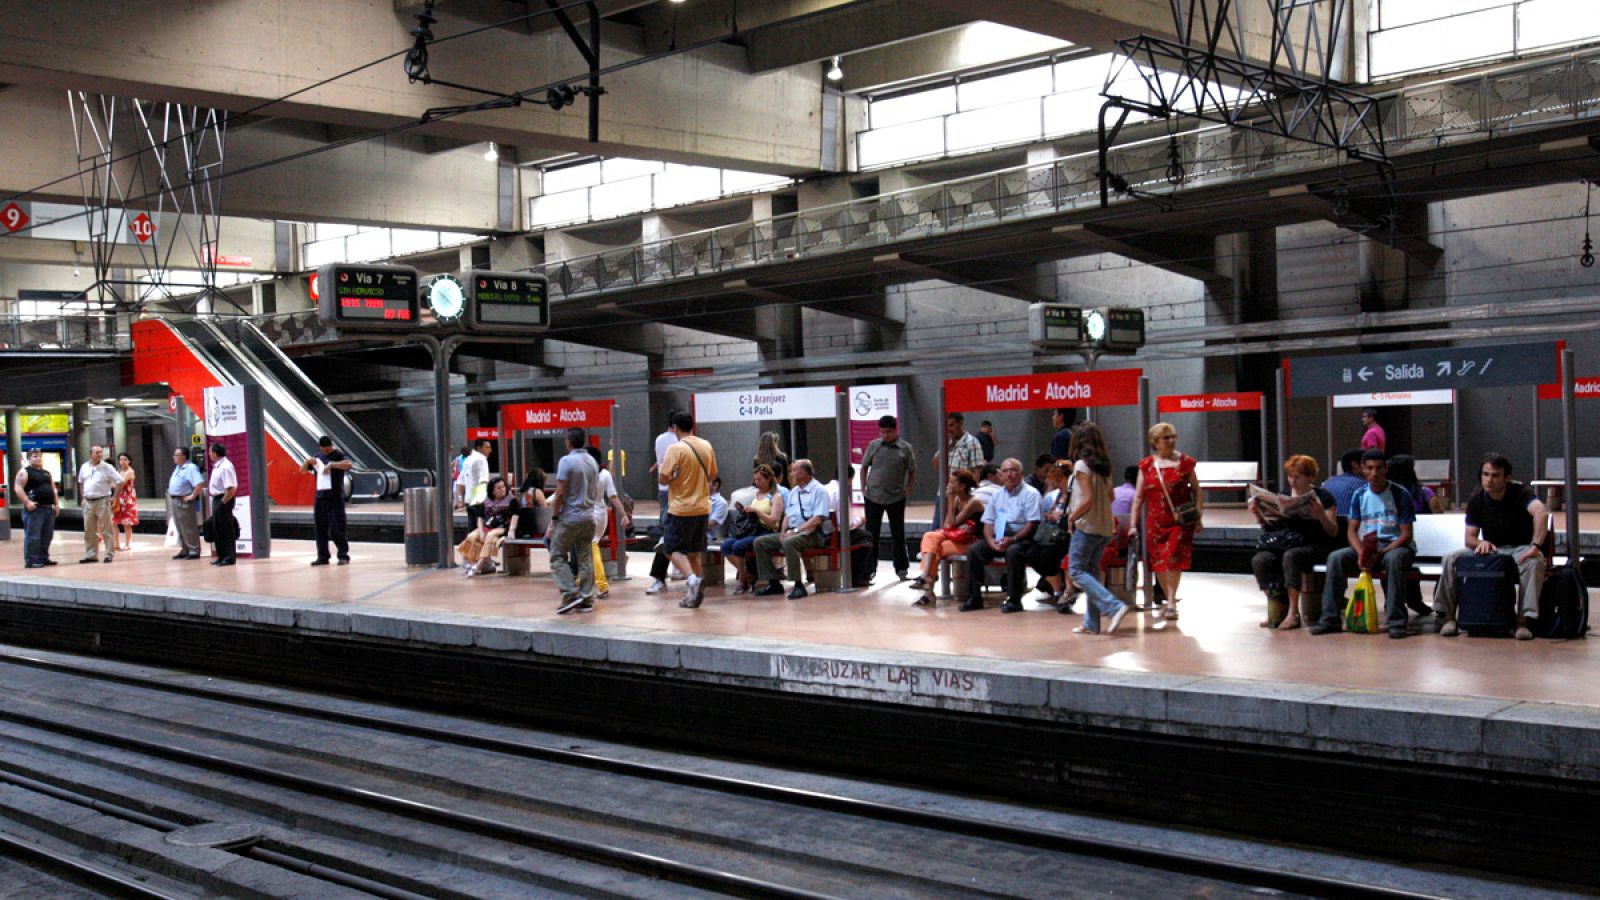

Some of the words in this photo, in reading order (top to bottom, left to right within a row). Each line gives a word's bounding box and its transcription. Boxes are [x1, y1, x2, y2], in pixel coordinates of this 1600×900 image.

[7, 208, 21, 228] 9
[132, 220, 152, 236] 10
[376, 273, 384, 284] 7
[511, 280, 518, 291] 8
[1384, 363, 1425, 381] Salida
[739, 395, 752, 405] C-3
[754, 393, 787, 405] Aranjuez
[985, 382, 1029, 403] Madrid
[1044, 379, 1092, 400] Atocha
[739, 406, 752, 416] C-4
[754, 405, 773, 416] Parla
[1180, 398, 1204, 409] Madrid
[1212, 396, 1238, 408] Atocha
[526, 409, 551, 424] Madrid
[559, 407, 586, 422] Atocha
[886, 666, 920, 686] LAS
[931, 669, 975, 691] VIAS
